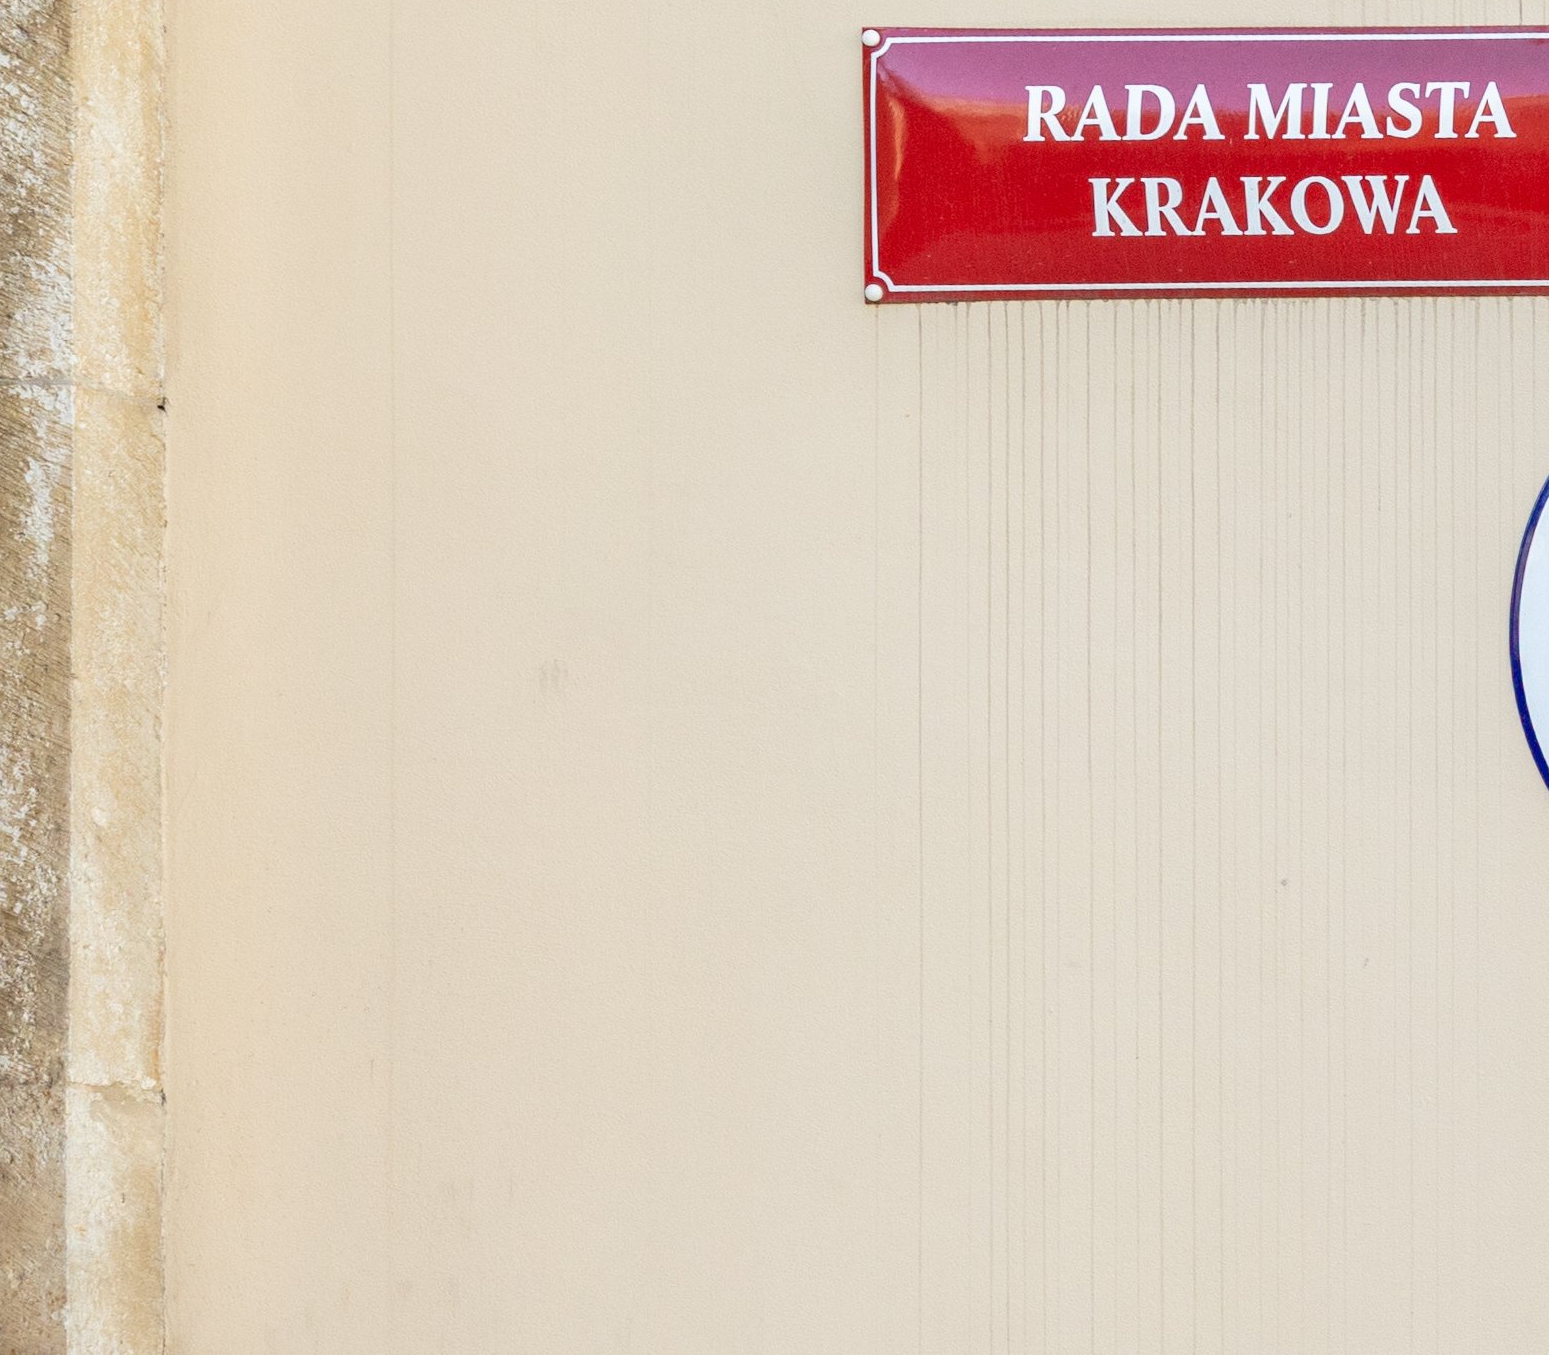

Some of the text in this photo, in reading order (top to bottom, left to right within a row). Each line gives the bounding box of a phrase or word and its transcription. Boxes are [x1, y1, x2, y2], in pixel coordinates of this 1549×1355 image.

[1022, 80, 1517, 142] RADA MIASTA
[1089, 174, 1458, 237] KRAKOWA
